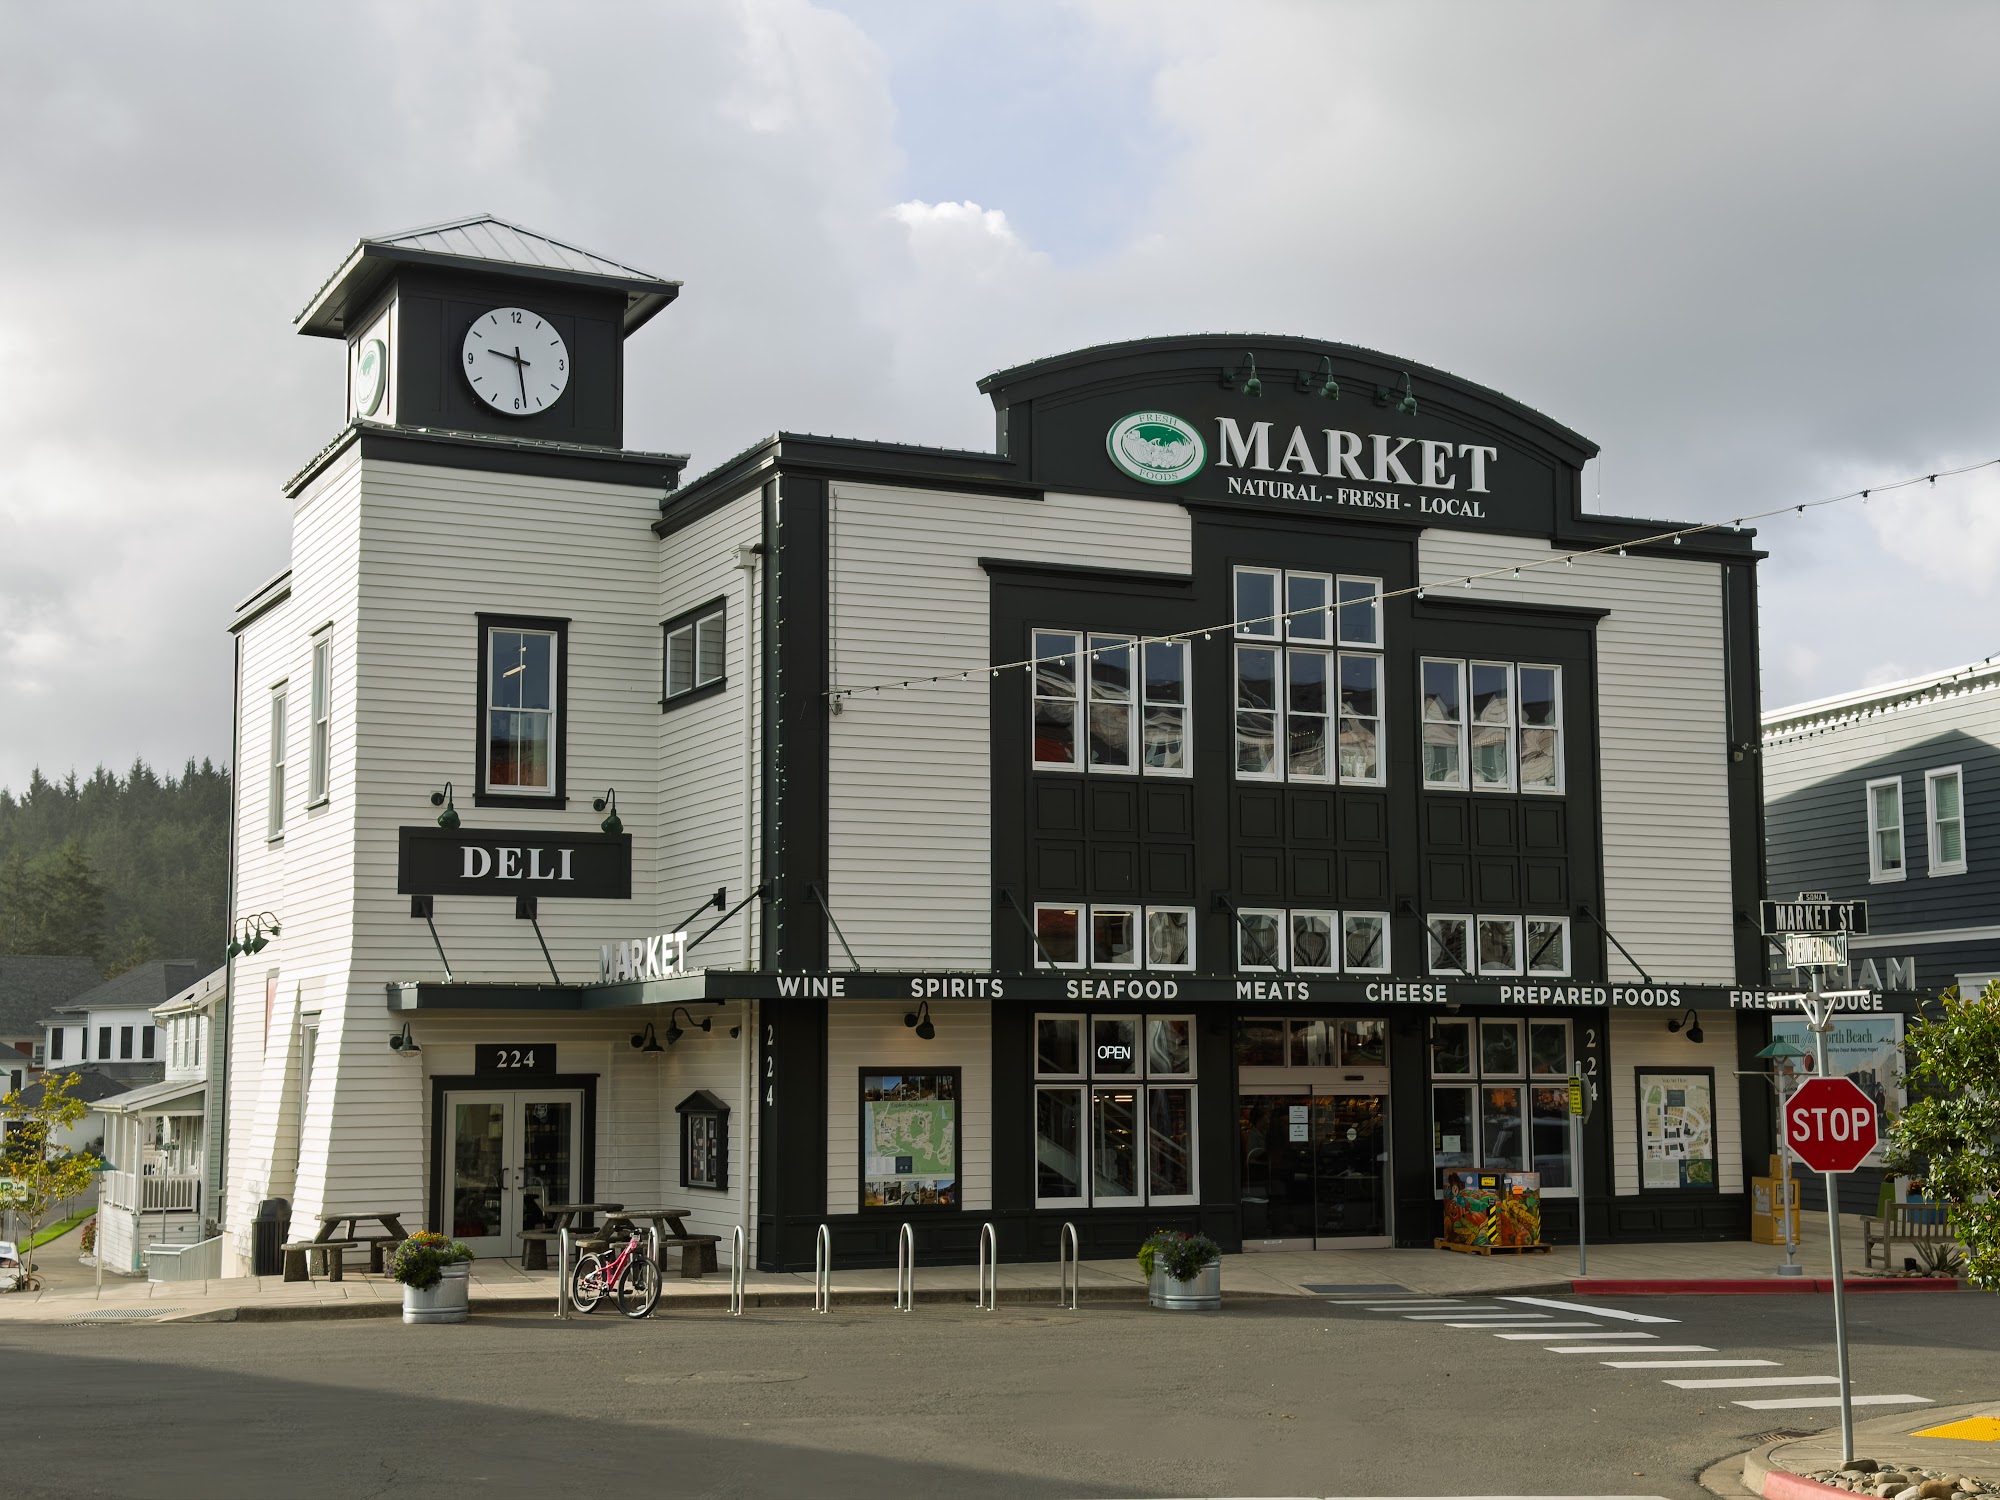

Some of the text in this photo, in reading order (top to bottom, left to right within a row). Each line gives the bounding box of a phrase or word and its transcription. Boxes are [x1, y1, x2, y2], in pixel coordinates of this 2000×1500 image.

[511, 311, 522, 324] 12
[467, 352, 474, 365] 9
[558, 358, 565, 371] 3
[514, 397, 520, 410] 6
[1138, 413, 1178, 427] FRESH
[1213, 415, 1498, 494] MARKET
[1138, 468, 1179, 481] FOODS
[1227, 476, 1323, 502] NATURAL
[1336, 487, 1400, 510] FRESH
[1419, 495, 1487, 519] LOCAL
[459, 845, 575, 881] DELI
[1805, 893, 1823, 901] SOMA
[1775, 905, 1855, 931] MARKET ST
[599, 930, 688, 984] MARKET
[1836, 935, 1845, 962] ST
[776, 976, 845, 998] WINE
[911, 978, 1004, 999] SPIRITS
[1066, 979, 1179, 1000] SEAFOOD
[1236, 981, 1310, 1001] MEATS
[1365, 983, 1448, 1003] CHEESE
[1500, 985, 1607, 1006] PREPARED
[1612, 987, 1682, 1007] FOODS
[1826, 1029, 1845, 1044] orth
[1845, 1028, 1873, 1044] Beach
[496, 1050, 536, 1069] 224
[1097, 1045, 1131, 1060] OPEN
[1792, 1107, 1871, 1142] STOP
